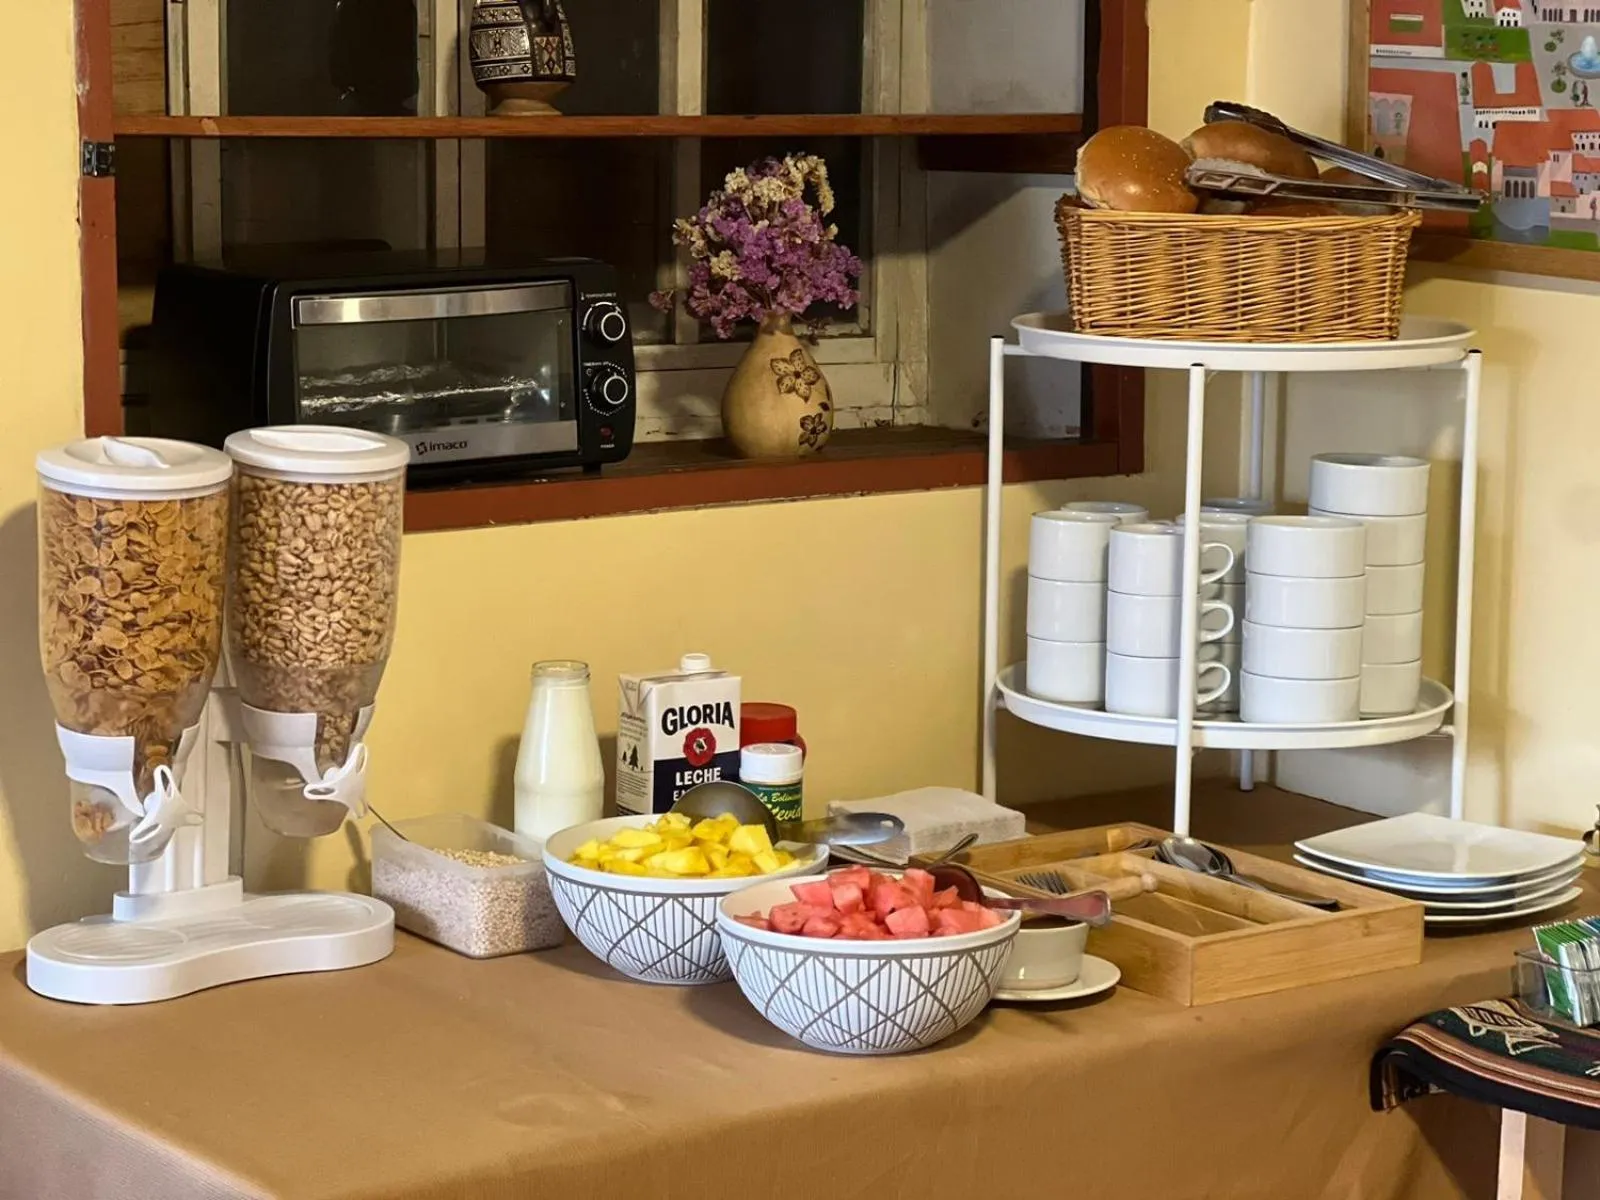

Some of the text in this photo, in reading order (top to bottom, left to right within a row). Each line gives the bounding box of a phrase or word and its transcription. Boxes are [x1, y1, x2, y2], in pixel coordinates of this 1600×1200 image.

[429, 441, 467, 451] imaco
[661, 701, 735, 736] GLORIA
[675, 767, 721, 786] LECHE
